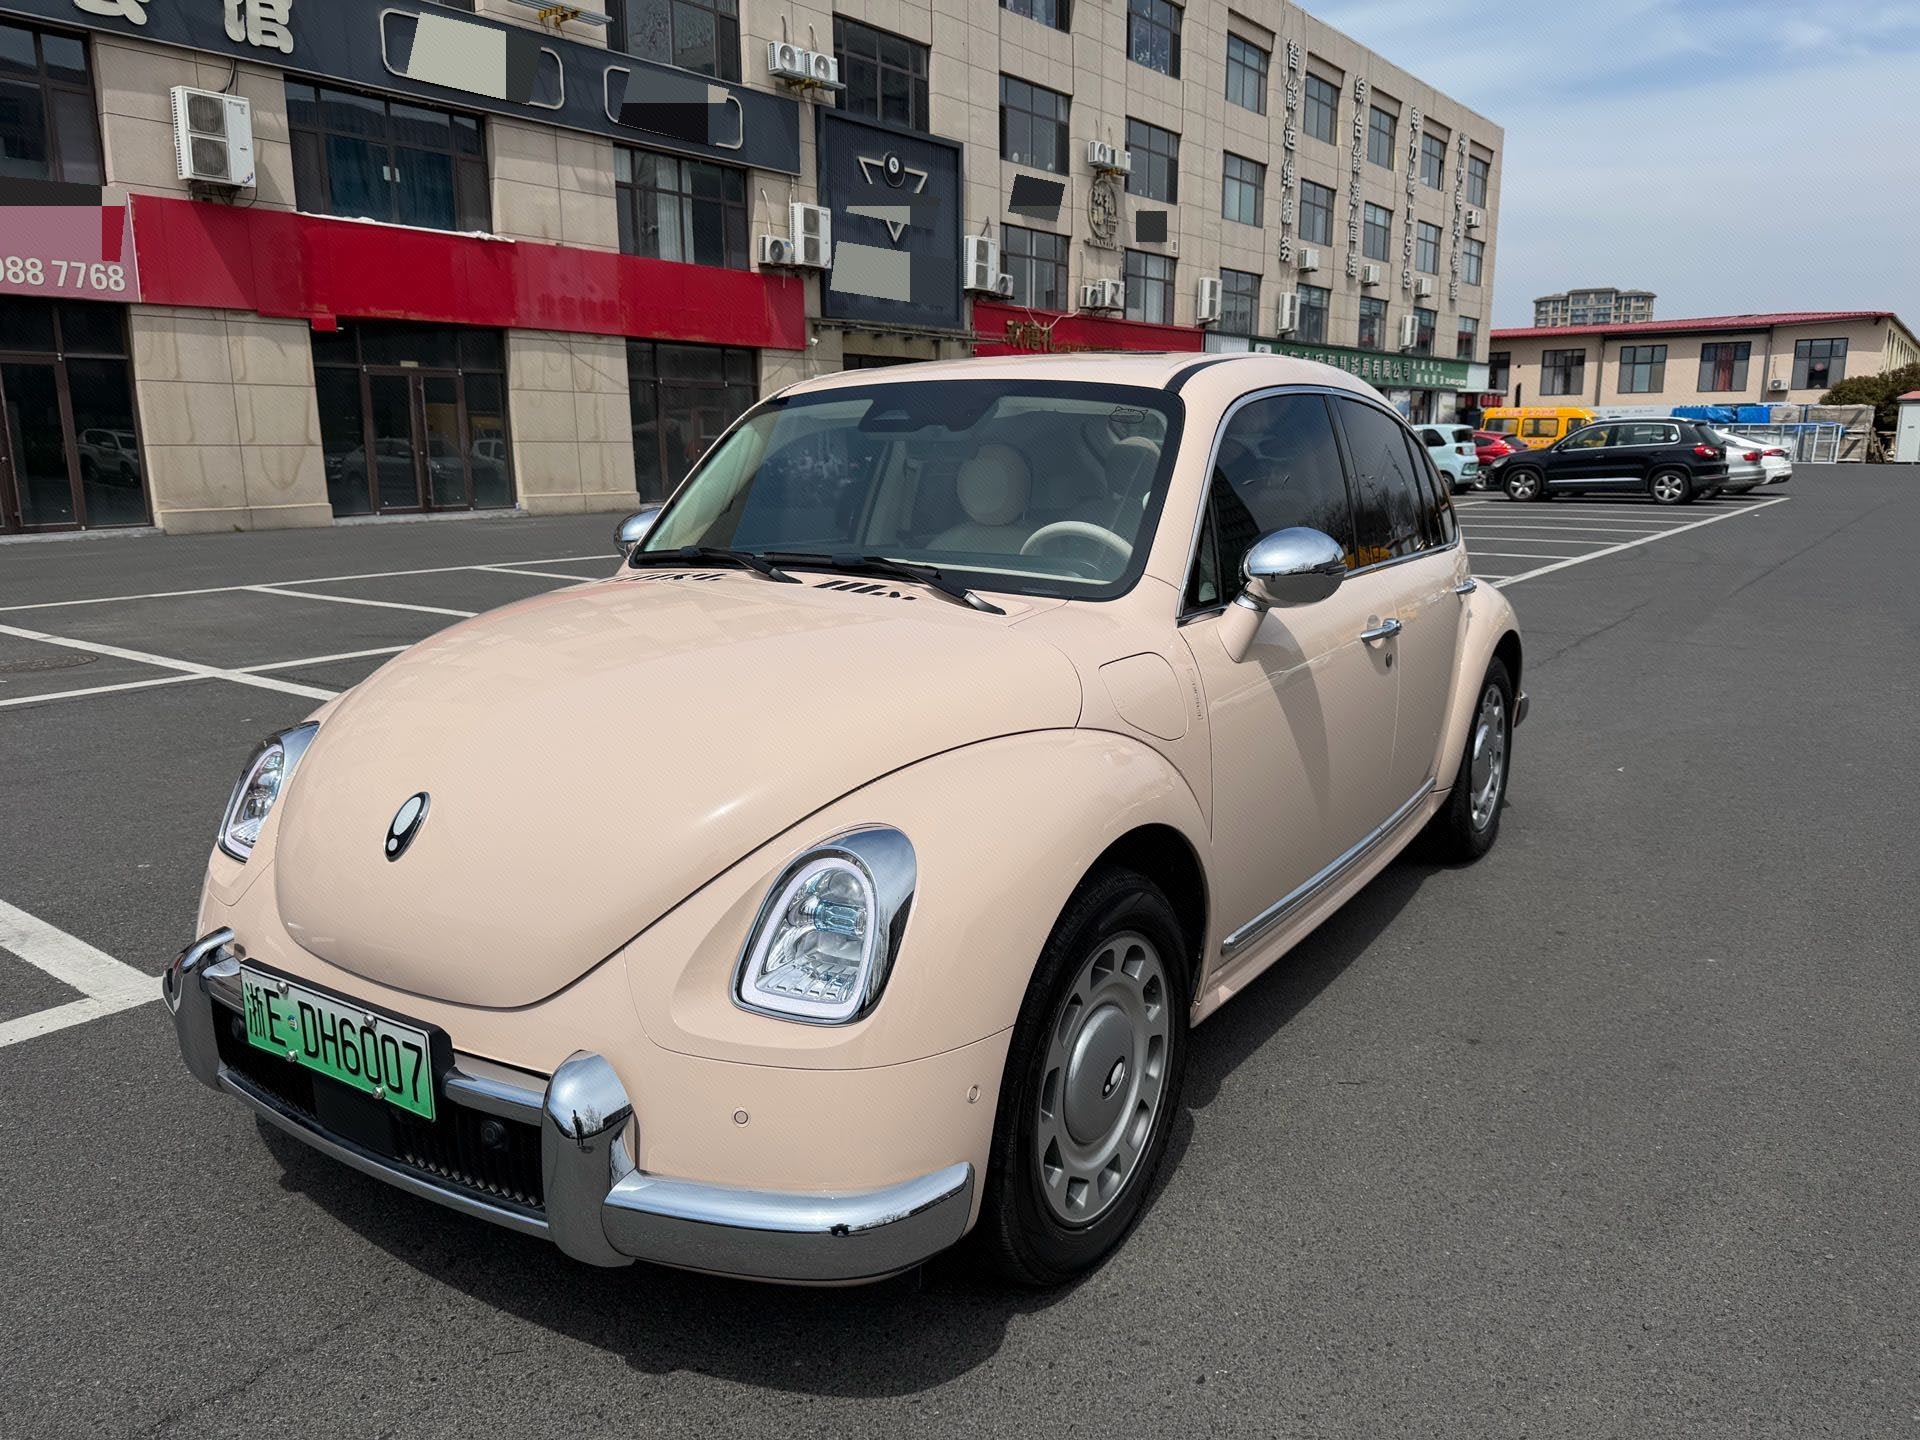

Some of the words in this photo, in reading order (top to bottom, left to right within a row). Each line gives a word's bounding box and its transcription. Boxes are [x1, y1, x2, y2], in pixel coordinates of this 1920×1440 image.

[1279, 38, 1301, 262] 智能运维服务
[0, 256, 45, 285] 88
[51, 260, 126, 292] 7768
[244, 981, 287, 1047] 浙E
[297, 1000, 424, 1103] DH6007
